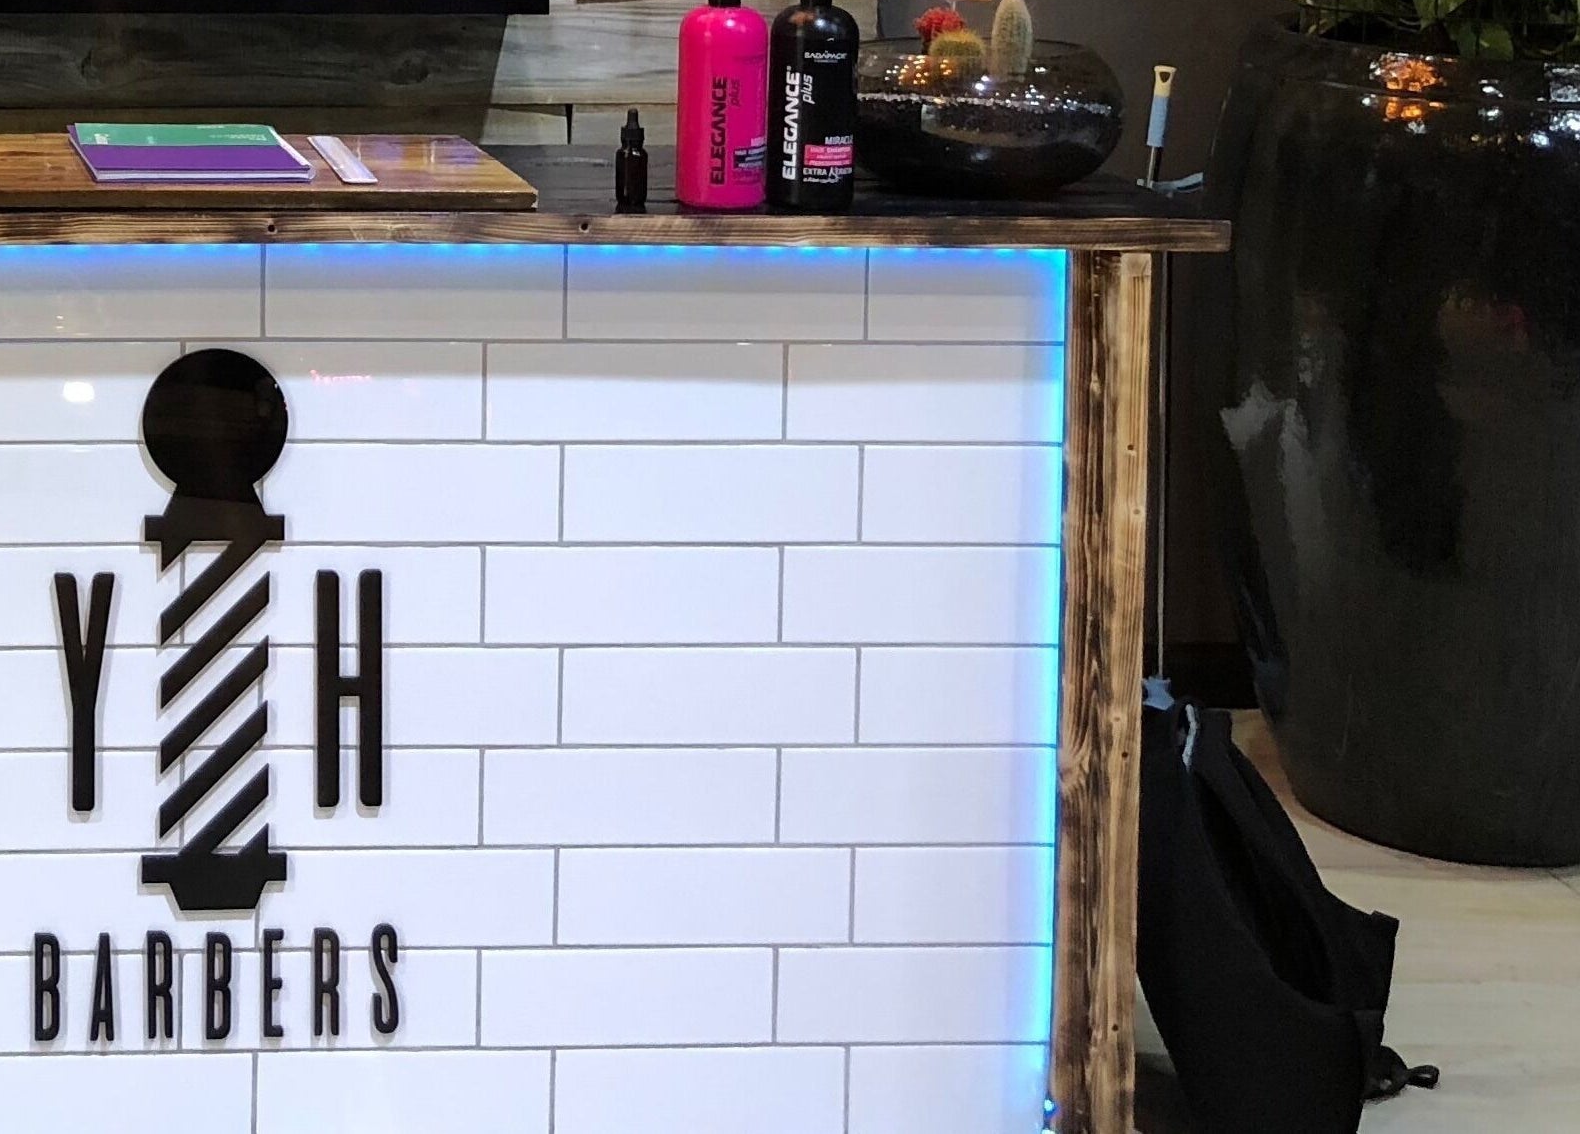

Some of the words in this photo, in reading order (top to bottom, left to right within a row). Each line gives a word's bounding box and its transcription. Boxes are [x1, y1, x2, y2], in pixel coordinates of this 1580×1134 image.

[710, 76, 727, 185] ELEGANCE
[782, 71, 800, 180] ELEGANCE
[802, 74, 815, 104] plus
[802, 167, 828, 176] EXTRA
[53, 571, 115, 813] Y
[316, 569, 383, 808] H
[34, 923, 399, 1042] BARBERS
